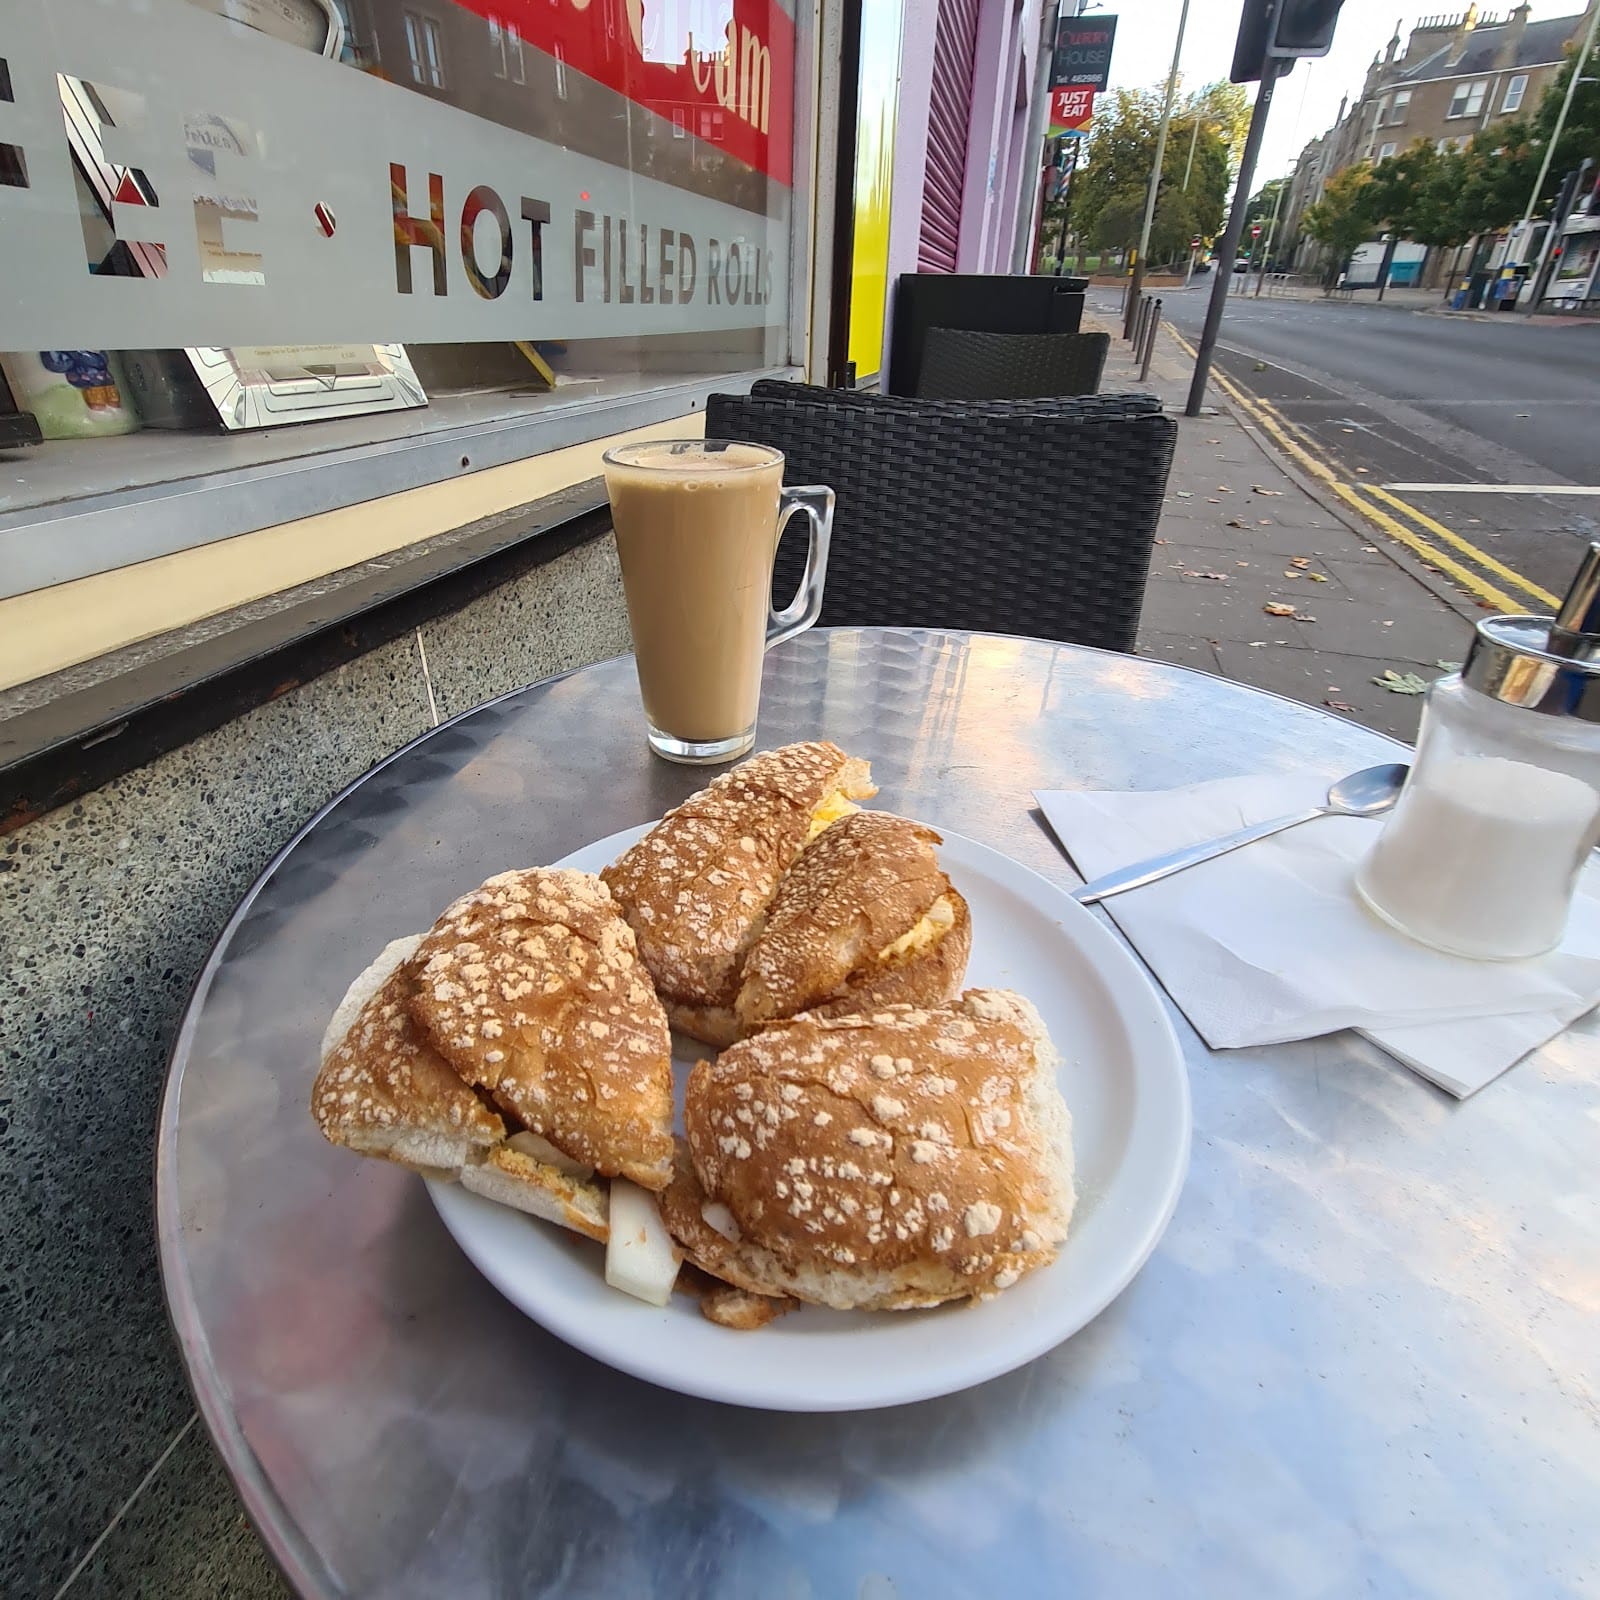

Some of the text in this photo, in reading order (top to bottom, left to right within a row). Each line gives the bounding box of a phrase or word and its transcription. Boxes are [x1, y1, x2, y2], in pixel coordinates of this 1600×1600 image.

[1059, 49, 1105, 67] HOUSE
[1057, 90, 1090, 107] JUST
[1062, 104, 1087, 117] EAT
[389, 162, 551, 301] HOT
[575, 208, 697, 305] FILLED
[707, 238, 774, 306] ROLLS
